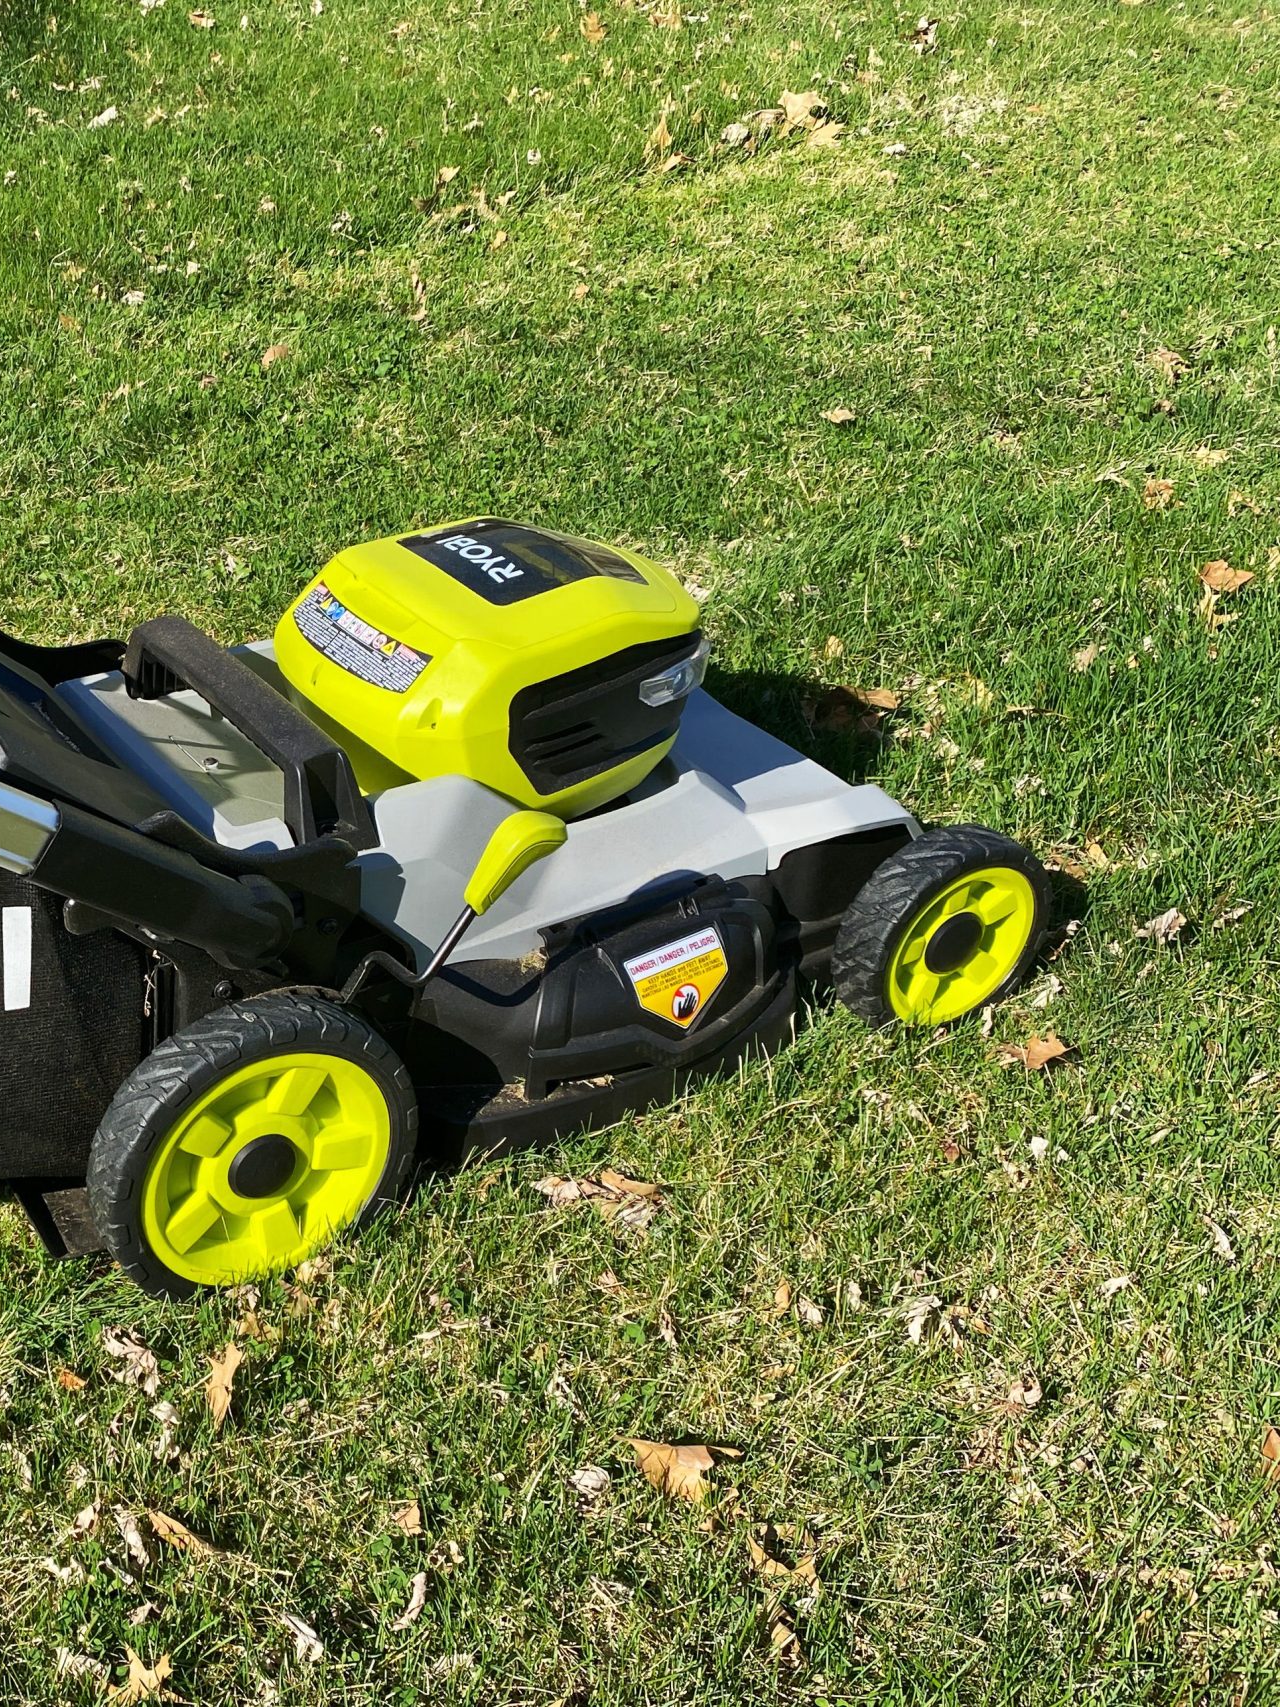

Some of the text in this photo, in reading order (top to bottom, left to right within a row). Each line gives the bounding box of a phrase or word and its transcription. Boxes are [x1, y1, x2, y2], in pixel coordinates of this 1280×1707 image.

[435, 534, 524, 584] RYOBI
[630, 958, 657, 976] DANGER
[658, 947, 686, 964] DANGER
[689, 935, 716, 952] PELIGRO
